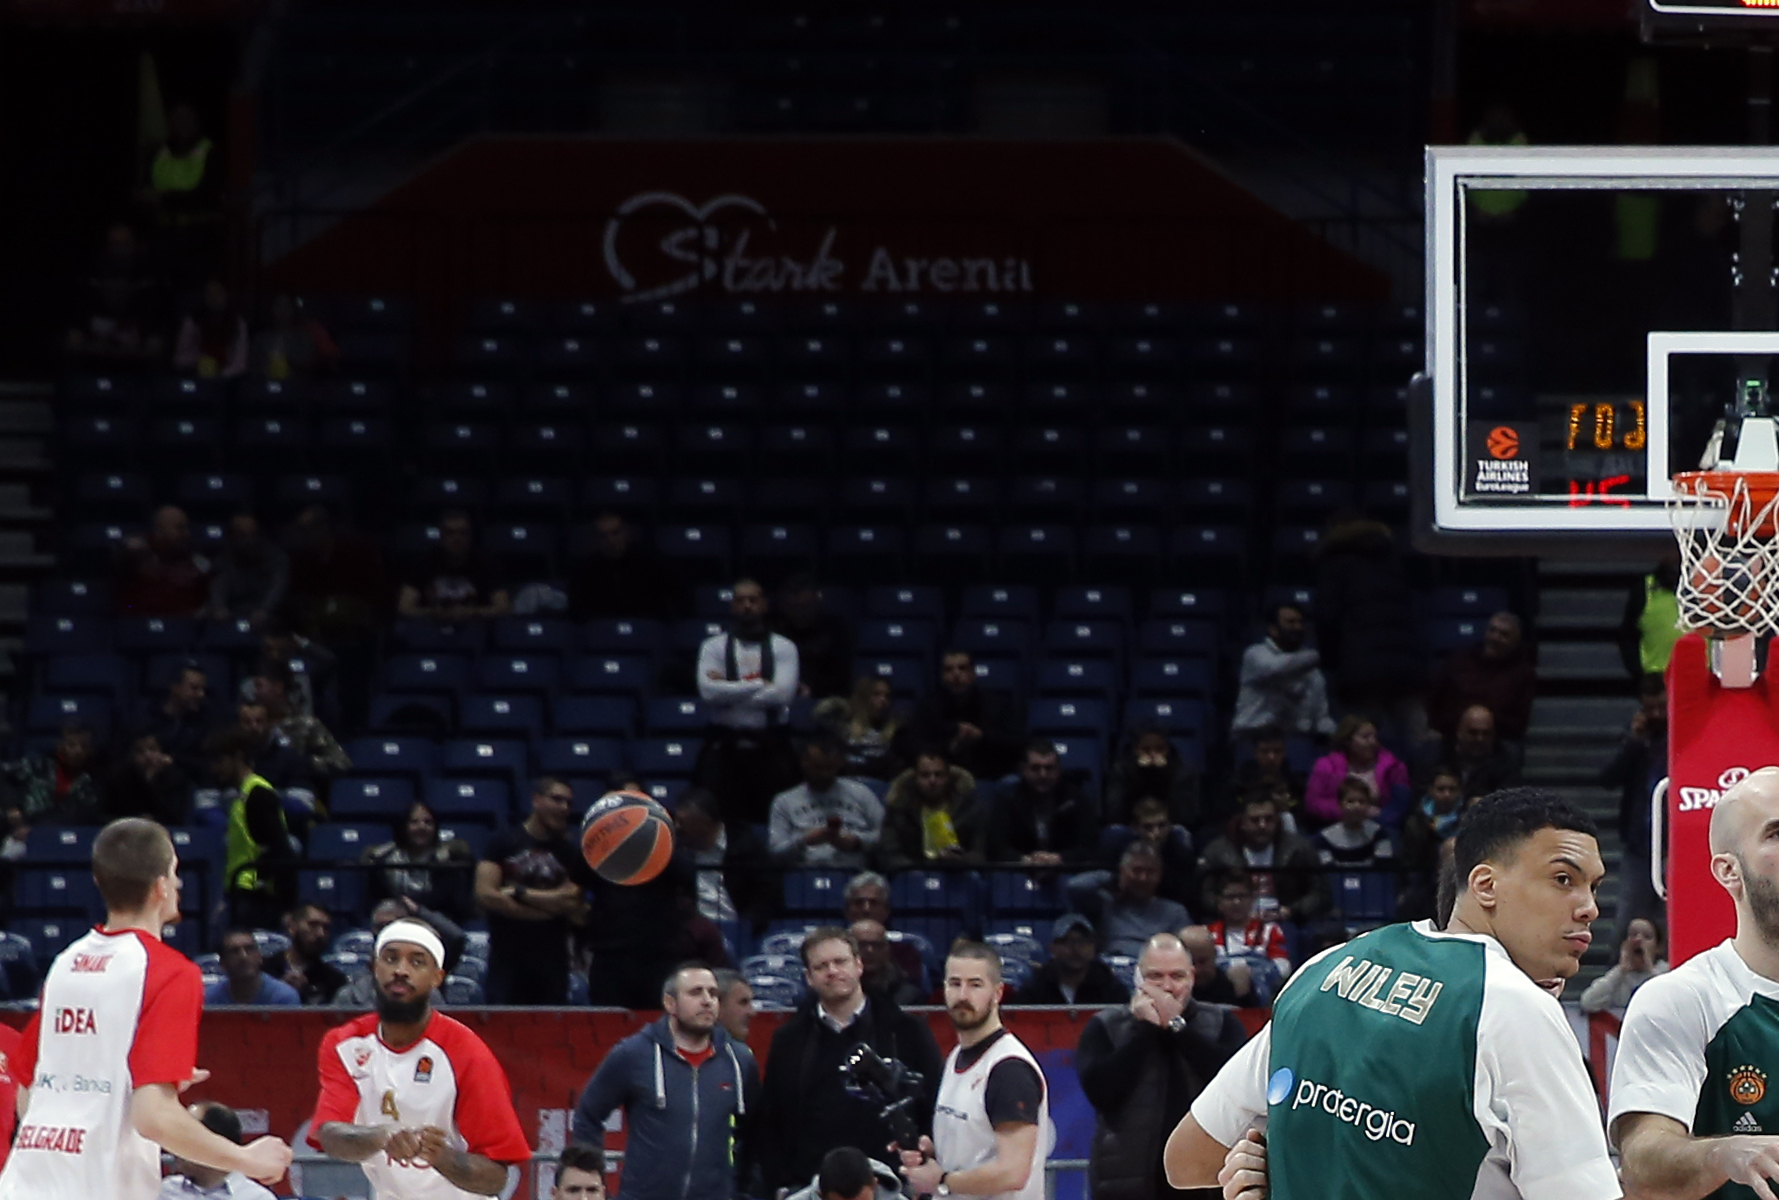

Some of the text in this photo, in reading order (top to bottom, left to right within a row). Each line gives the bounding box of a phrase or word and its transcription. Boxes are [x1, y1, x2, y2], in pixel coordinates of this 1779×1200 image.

[1320, 956, 1443, 1025] WILEY
[381, 1090, 399, 1121] 4
[1292, 1078, 1415, 1146] protergia
[1733, 1124, 1762, 1132] adidas
